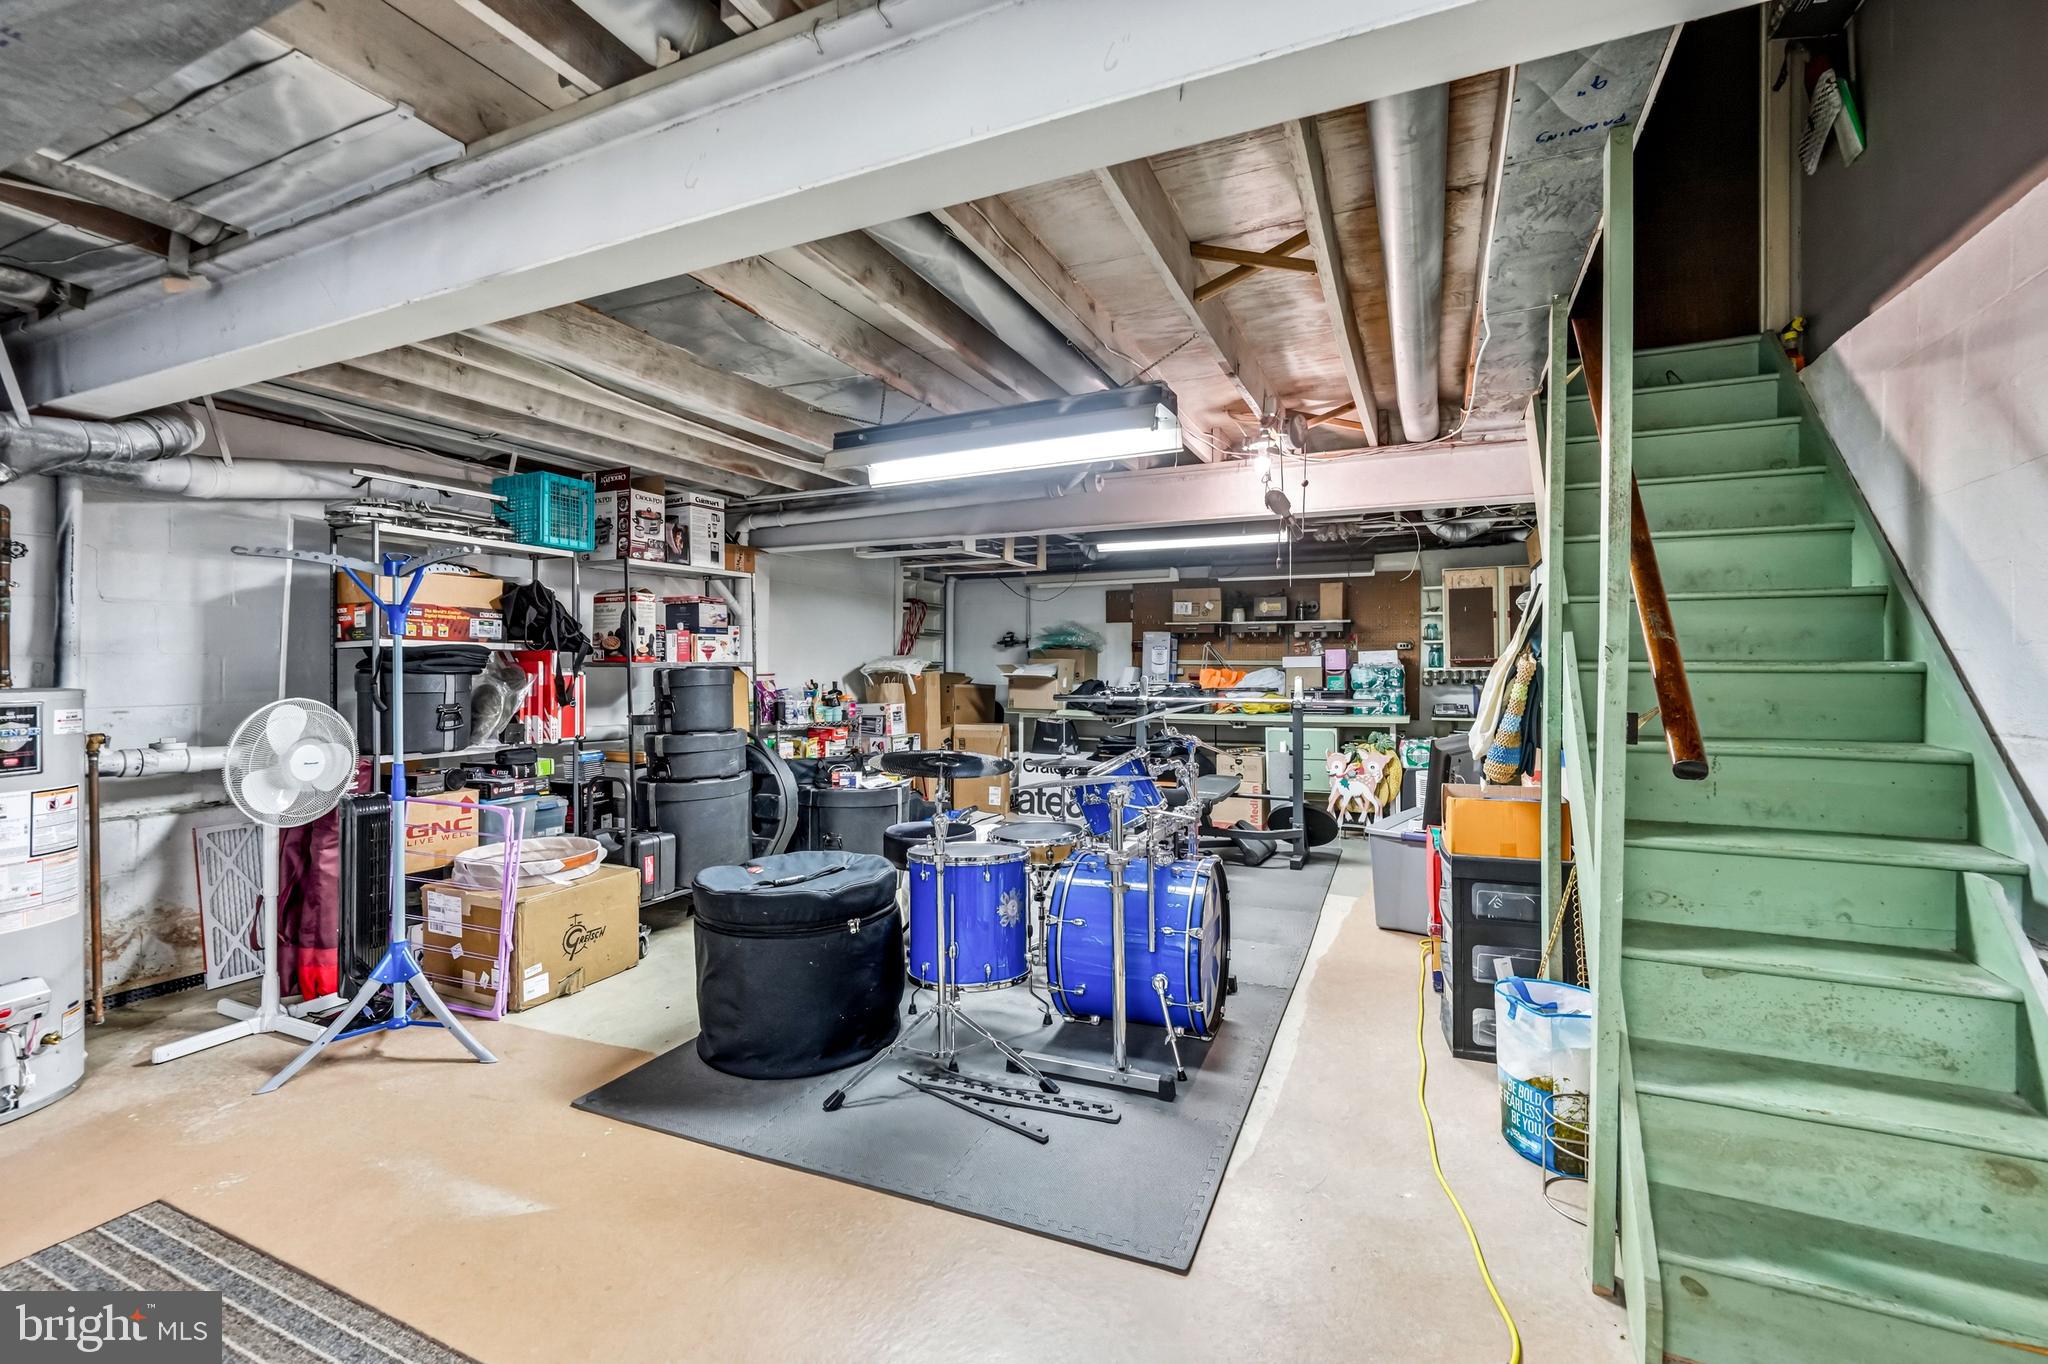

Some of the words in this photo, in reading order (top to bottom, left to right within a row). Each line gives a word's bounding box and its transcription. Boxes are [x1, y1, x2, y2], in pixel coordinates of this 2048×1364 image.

[1249, 785, 1260, 824] Medim
[406, 817, 473, 839] GNC
[406, 837, 435, 847] LIVE
[441, 831, 473, 841] WELL
[1503, 1088, 1542, 1122] FEARLESS
[1518, 1084, 1542, 1106] BOLD
[1511, 1109, 1521, 1128] BE
